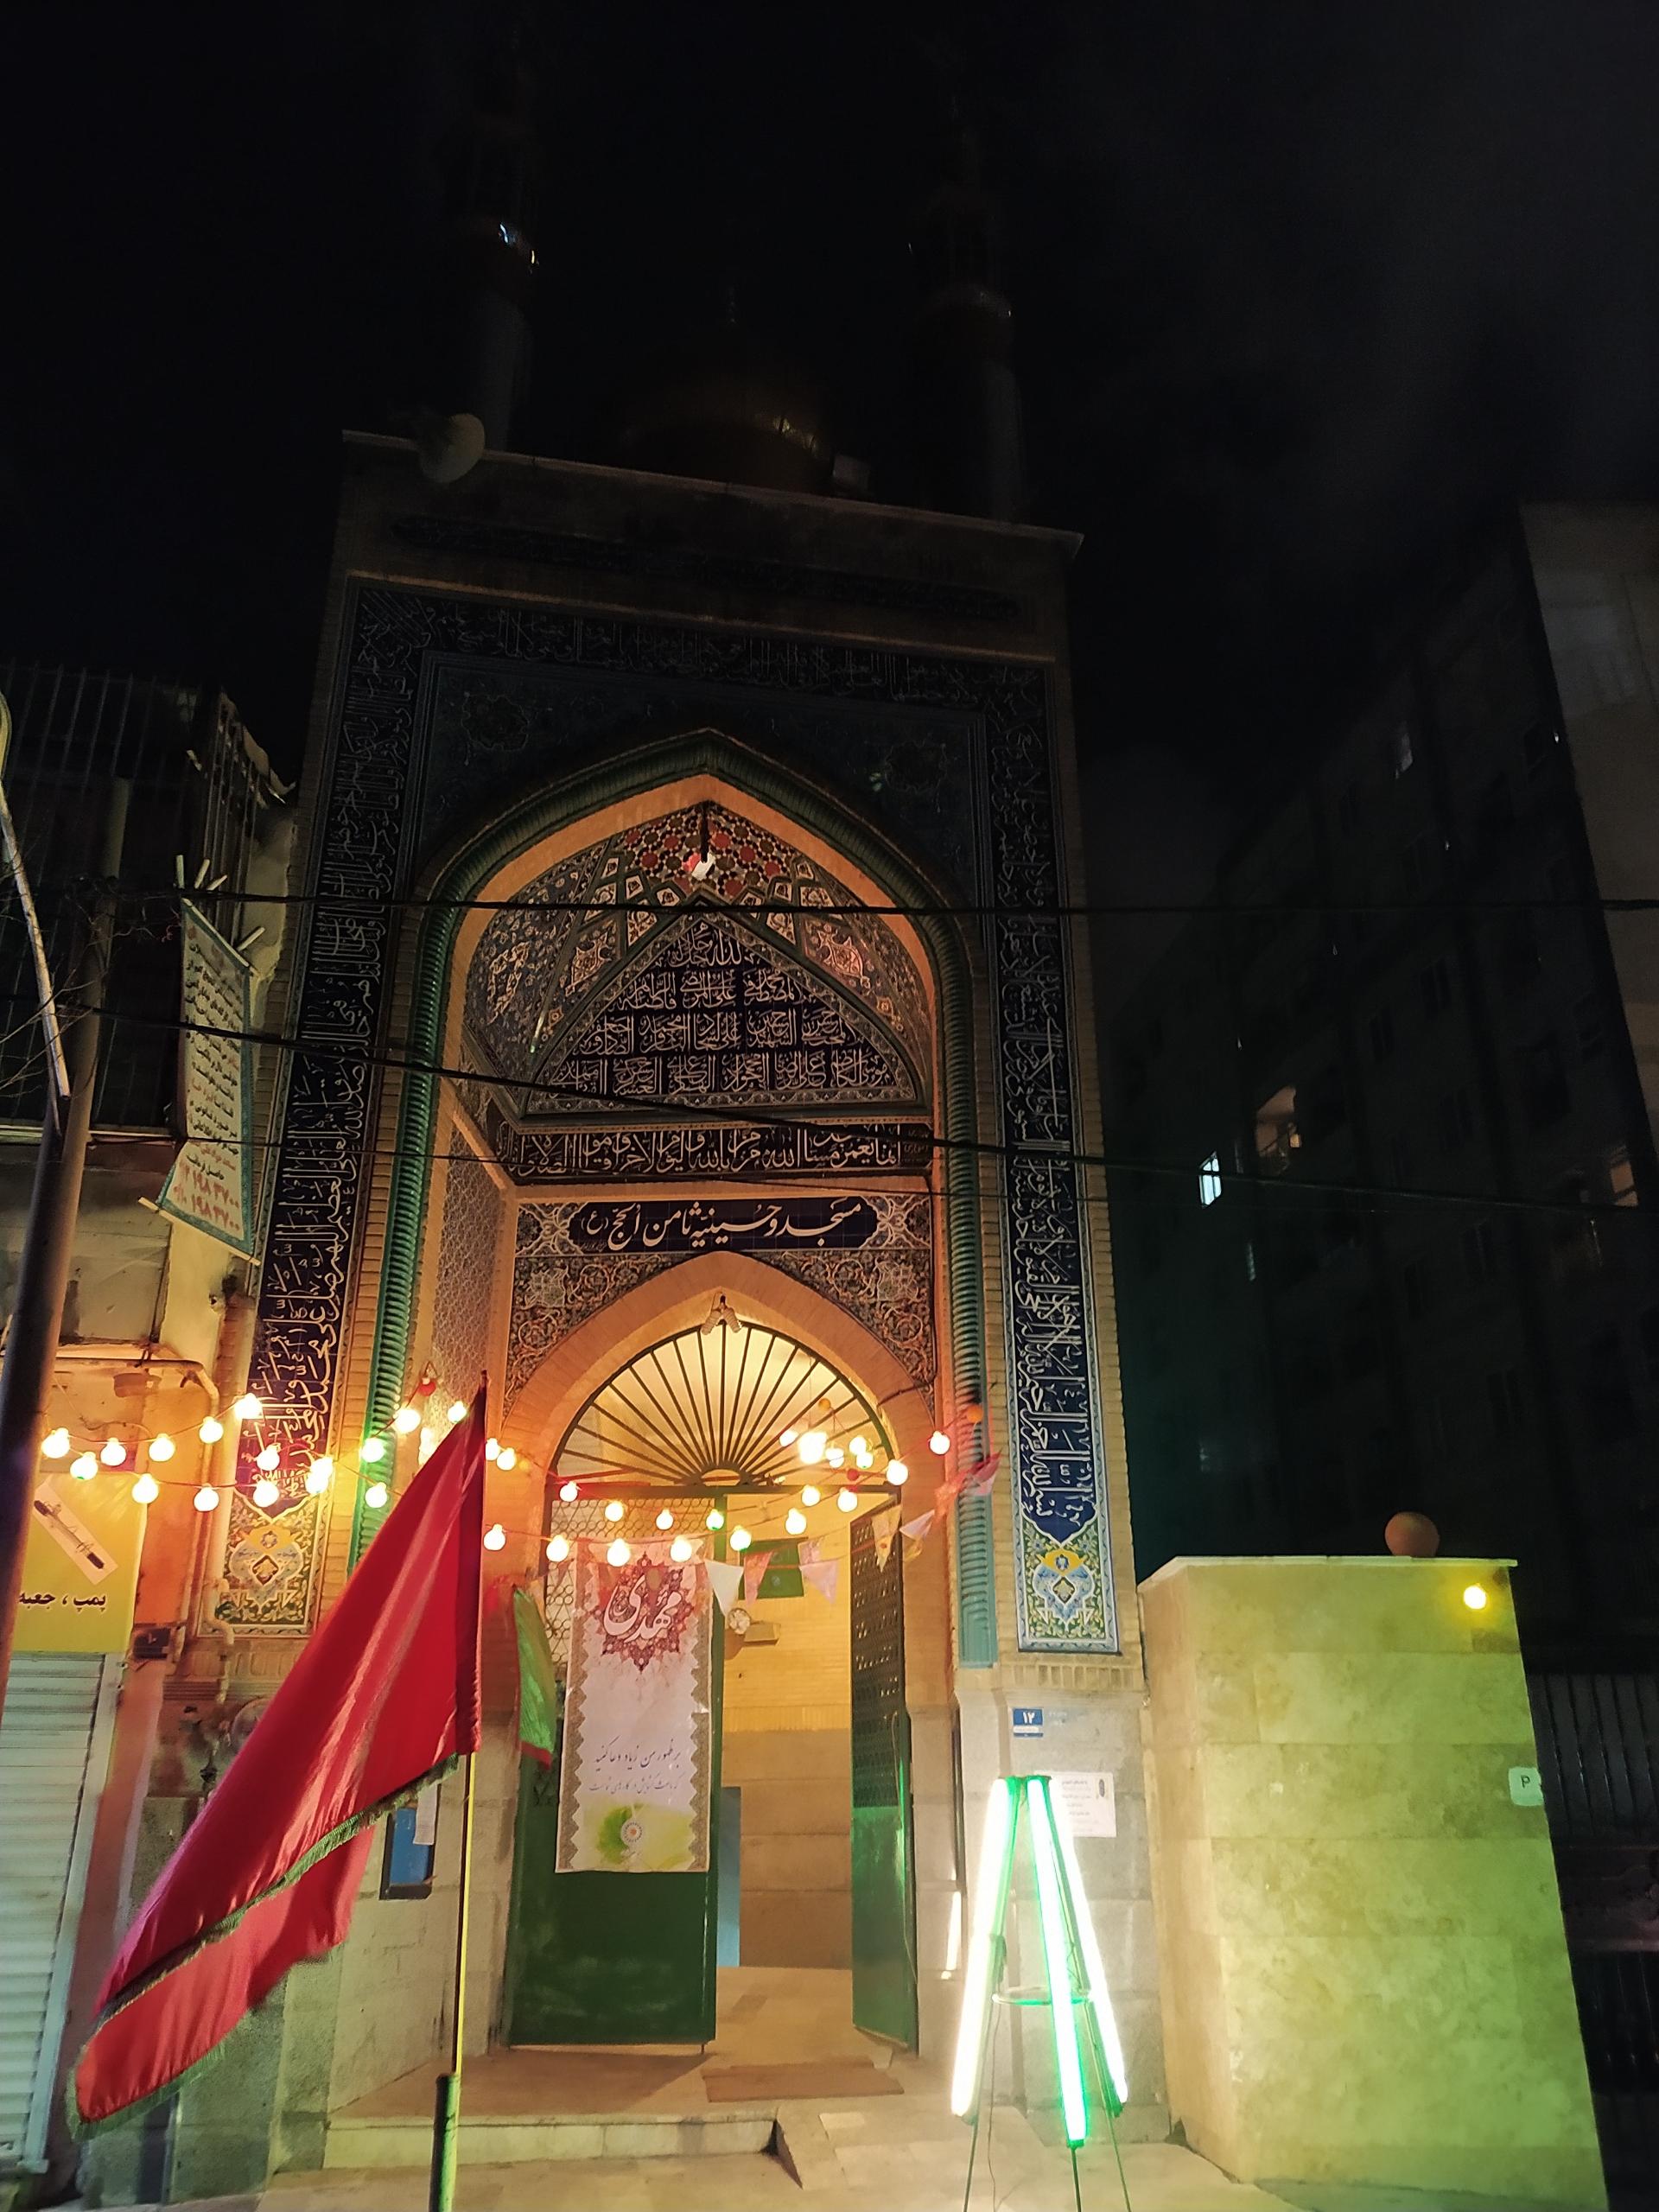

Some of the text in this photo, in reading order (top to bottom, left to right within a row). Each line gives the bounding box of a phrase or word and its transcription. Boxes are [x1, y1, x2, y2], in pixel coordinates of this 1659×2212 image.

[643, 1202, 702, 1248] ثامن
[776, 1202, 861, 1247] مسجد
[73, 1593, 106, 1613] پمپ
[603, 1573, 683, 1644] مهدی
[640, 1751, 657, 1769] من
[1520, 1775, 1530, 1789] P
